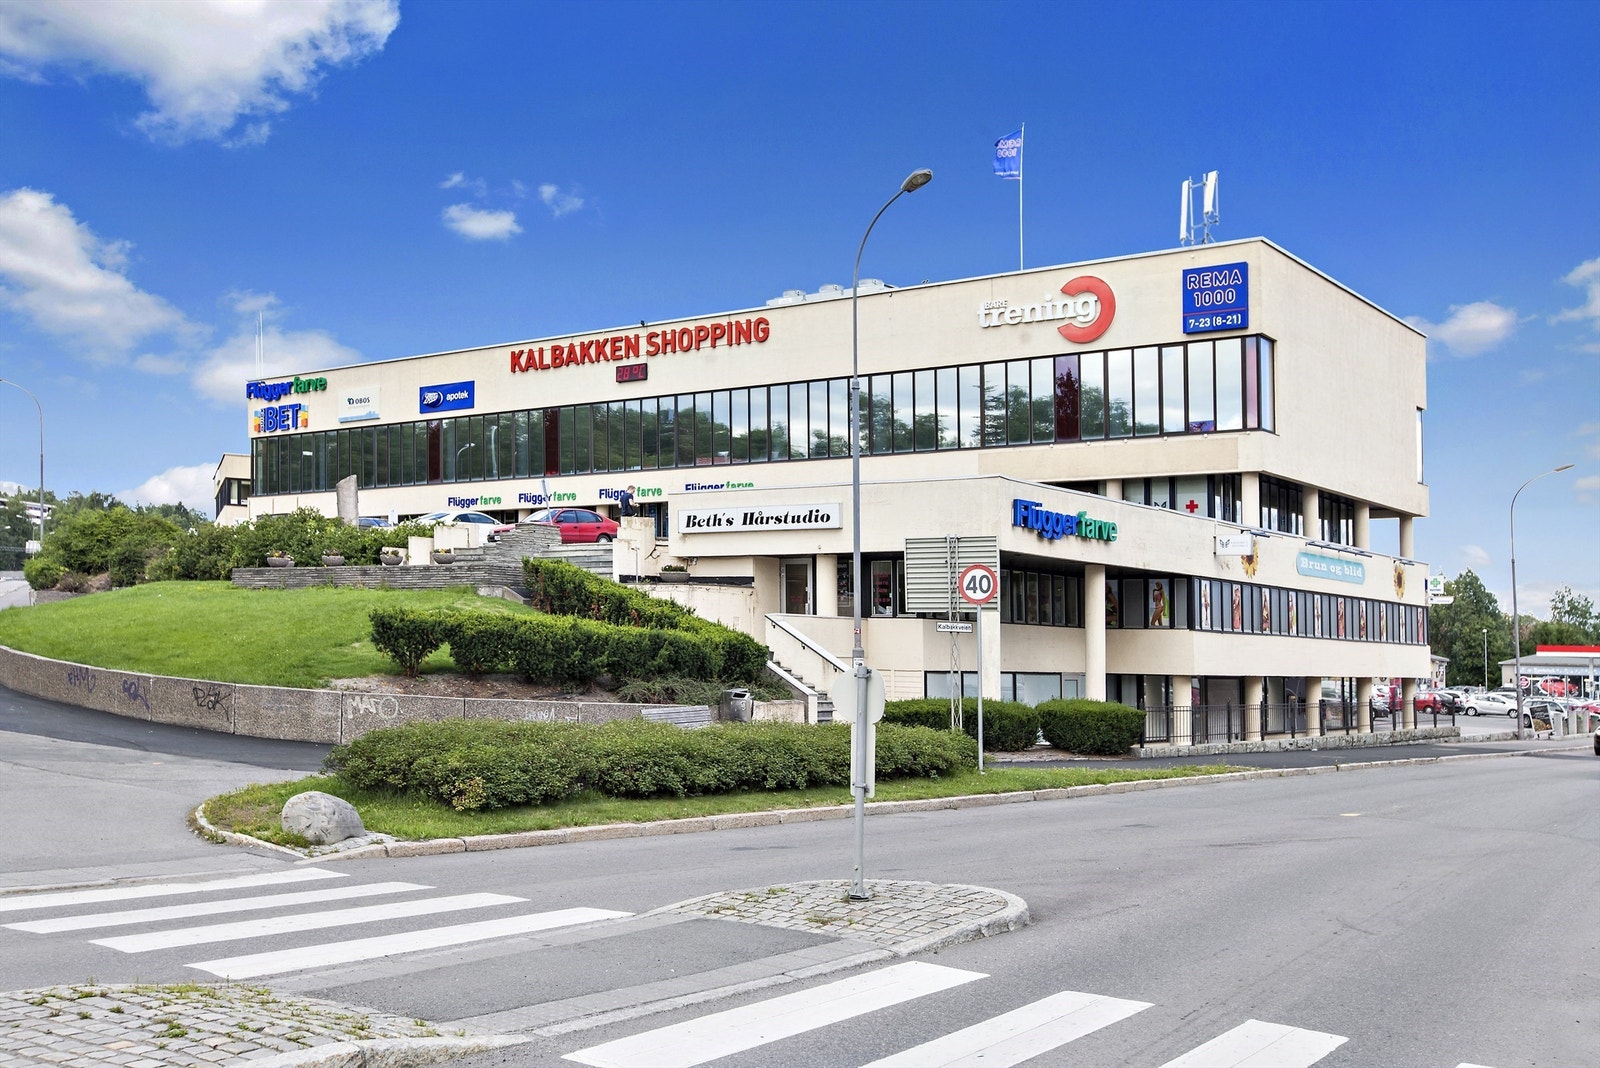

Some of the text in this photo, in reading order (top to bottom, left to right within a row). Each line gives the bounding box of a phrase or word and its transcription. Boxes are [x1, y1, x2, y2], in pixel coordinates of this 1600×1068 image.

[1187, 269, 1242, 290] REMA
[984, 300, 1008, 310] BARE
[1193, 288, 1236, 307] 1000
[977, 294, 1098, 329] trening
[1189, 313, 1242, 329] 7-23 (8-21)
[510, 316, 770, 373] KALBAKKEN SHOPPING
[446, 390, 469, 402] apotek
[265, 403, 302, 432] BET
[553, 491, 577, 502] farve
[636, 486, 663, 498] farve
[447, 495, 502, 509] Flügger farve
[741, 508, 831, 526] Hårstudio
[1013, 499, 1118, 542] Flügger farve
[1301, 557, 1362, 576] Brun og blid
[965, 574, 992, 594] 40
